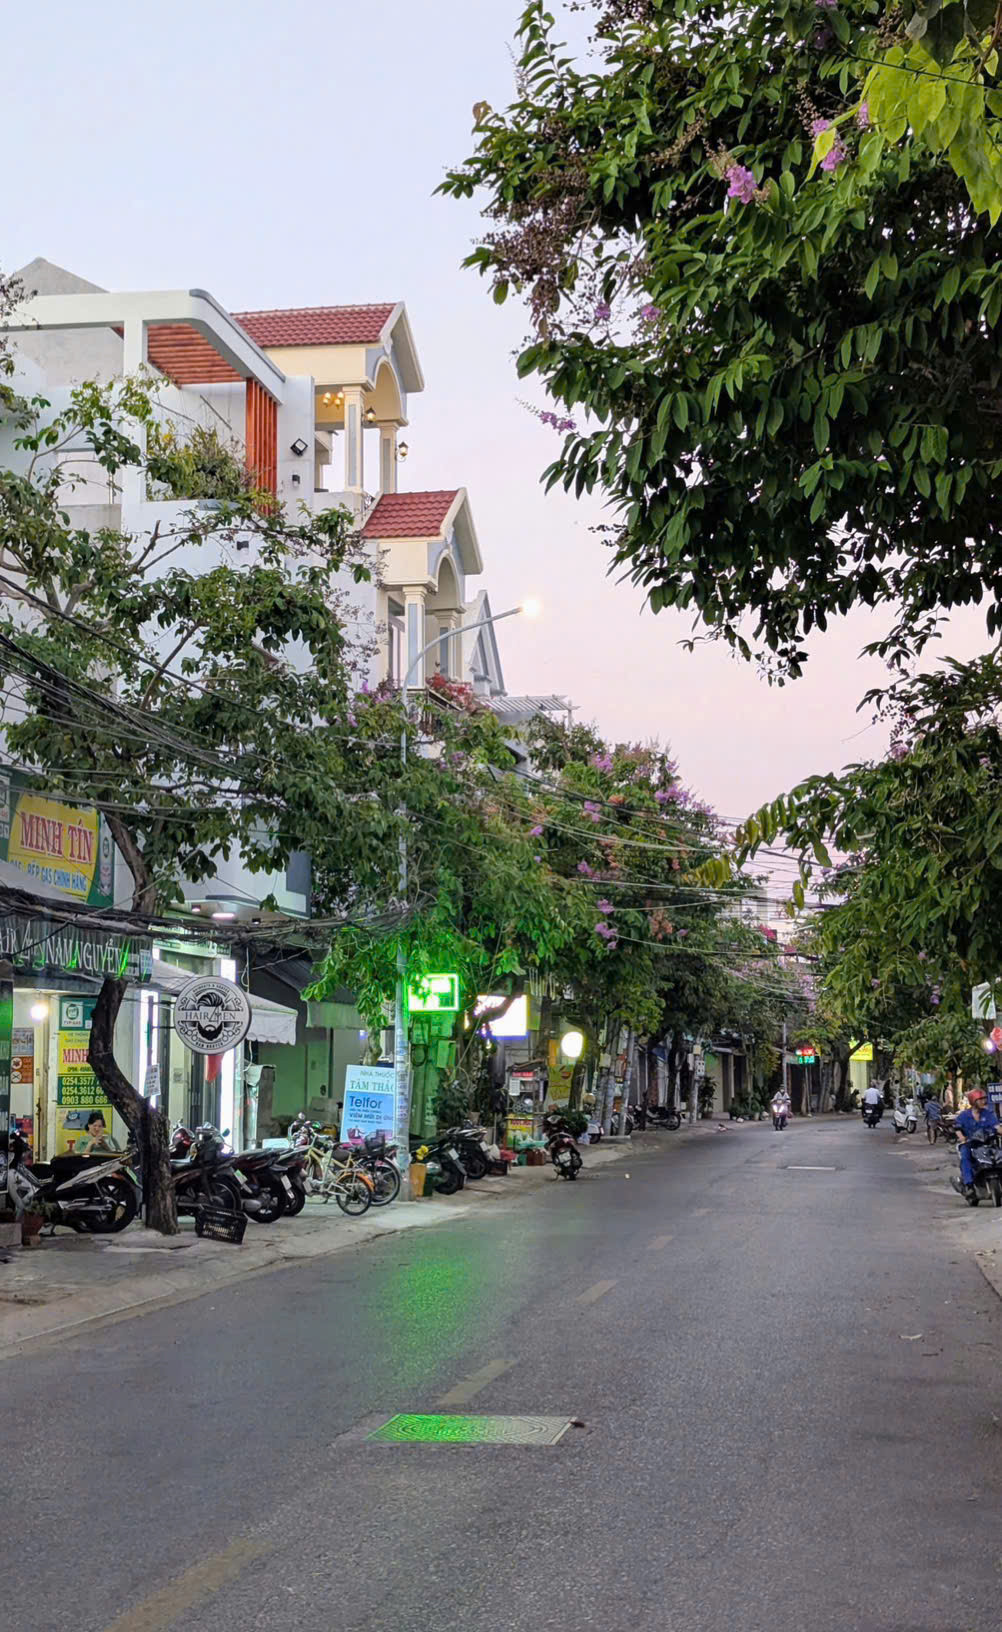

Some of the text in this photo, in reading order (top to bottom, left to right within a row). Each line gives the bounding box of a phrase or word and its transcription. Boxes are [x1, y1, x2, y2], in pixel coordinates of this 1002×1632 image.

[20, 811, 93, 863] MINH TÍN
[63, 1048, 90, 1063] MINH
[62, 1095, 79, 1105] 0903
[349, 1095, 383, 1109] Telfor
